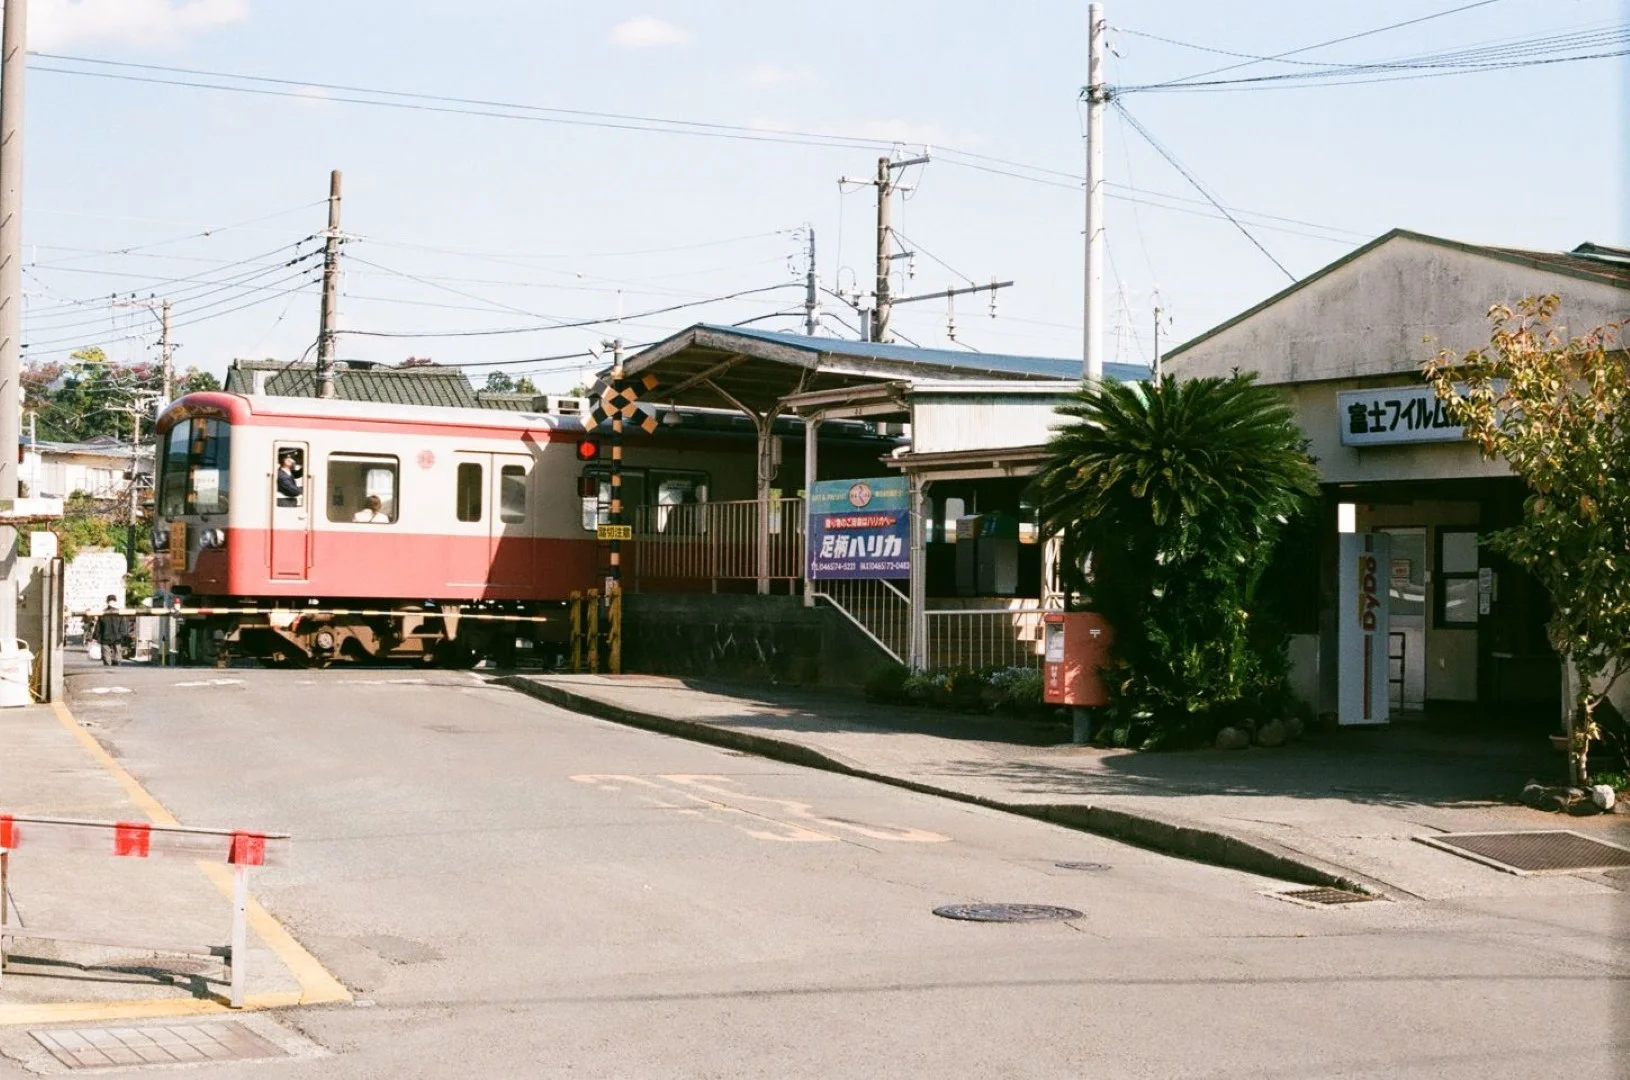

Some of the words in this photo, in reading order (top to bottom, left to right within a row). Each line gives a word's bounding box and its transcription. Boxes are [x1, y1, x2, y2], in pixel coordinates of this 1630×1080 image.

[1348, 397, 1489, 434] 富士フイルム
[820, 534, 902, 559] 足柄ハリカ
